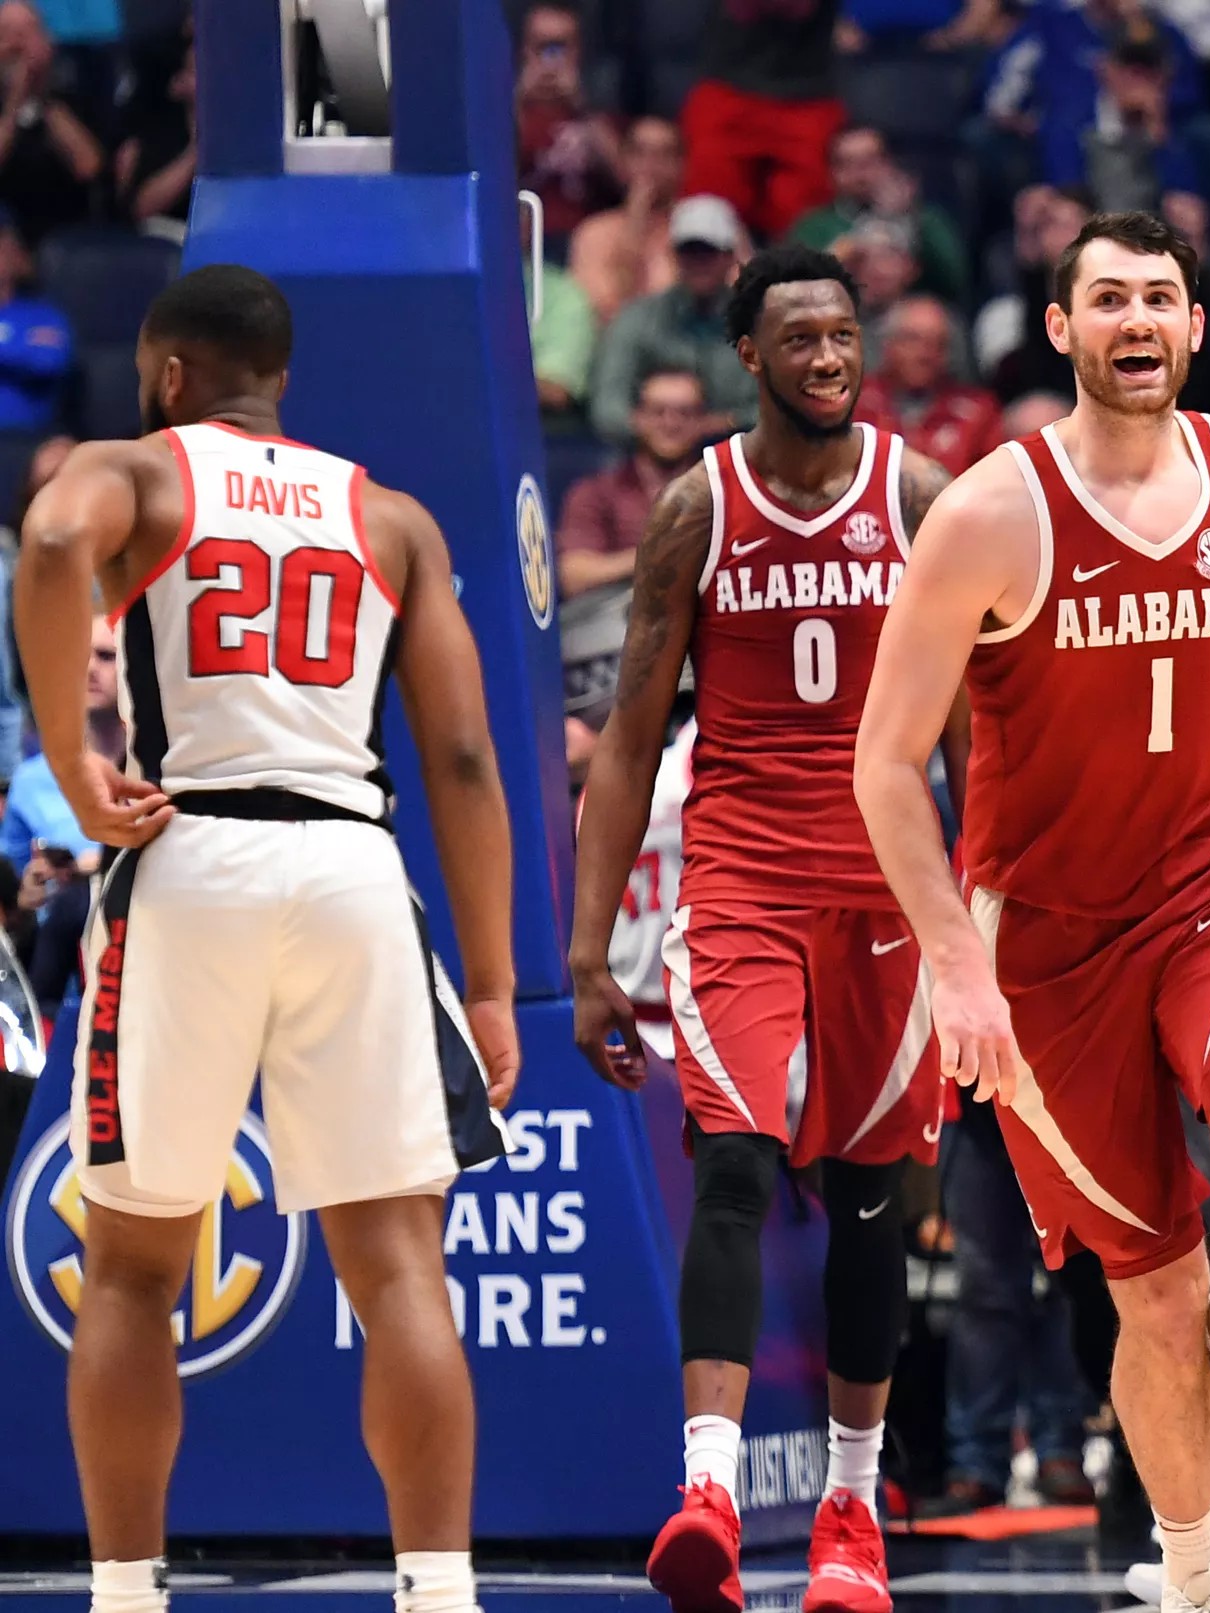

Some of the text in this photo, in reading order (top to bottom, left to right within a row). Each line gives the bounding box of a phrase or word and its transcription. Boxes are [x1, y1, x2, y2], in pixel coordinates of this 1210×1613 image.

[224, 470, 323, 520] DAVIS
[185, 536, 365, 689] 20
[793, 618, 837, 704] 0
[1147, 657, 1174, 752] 1
[90, 1050, 118, 1143] OLE
[444, 1191, 587, 1254] ANS
